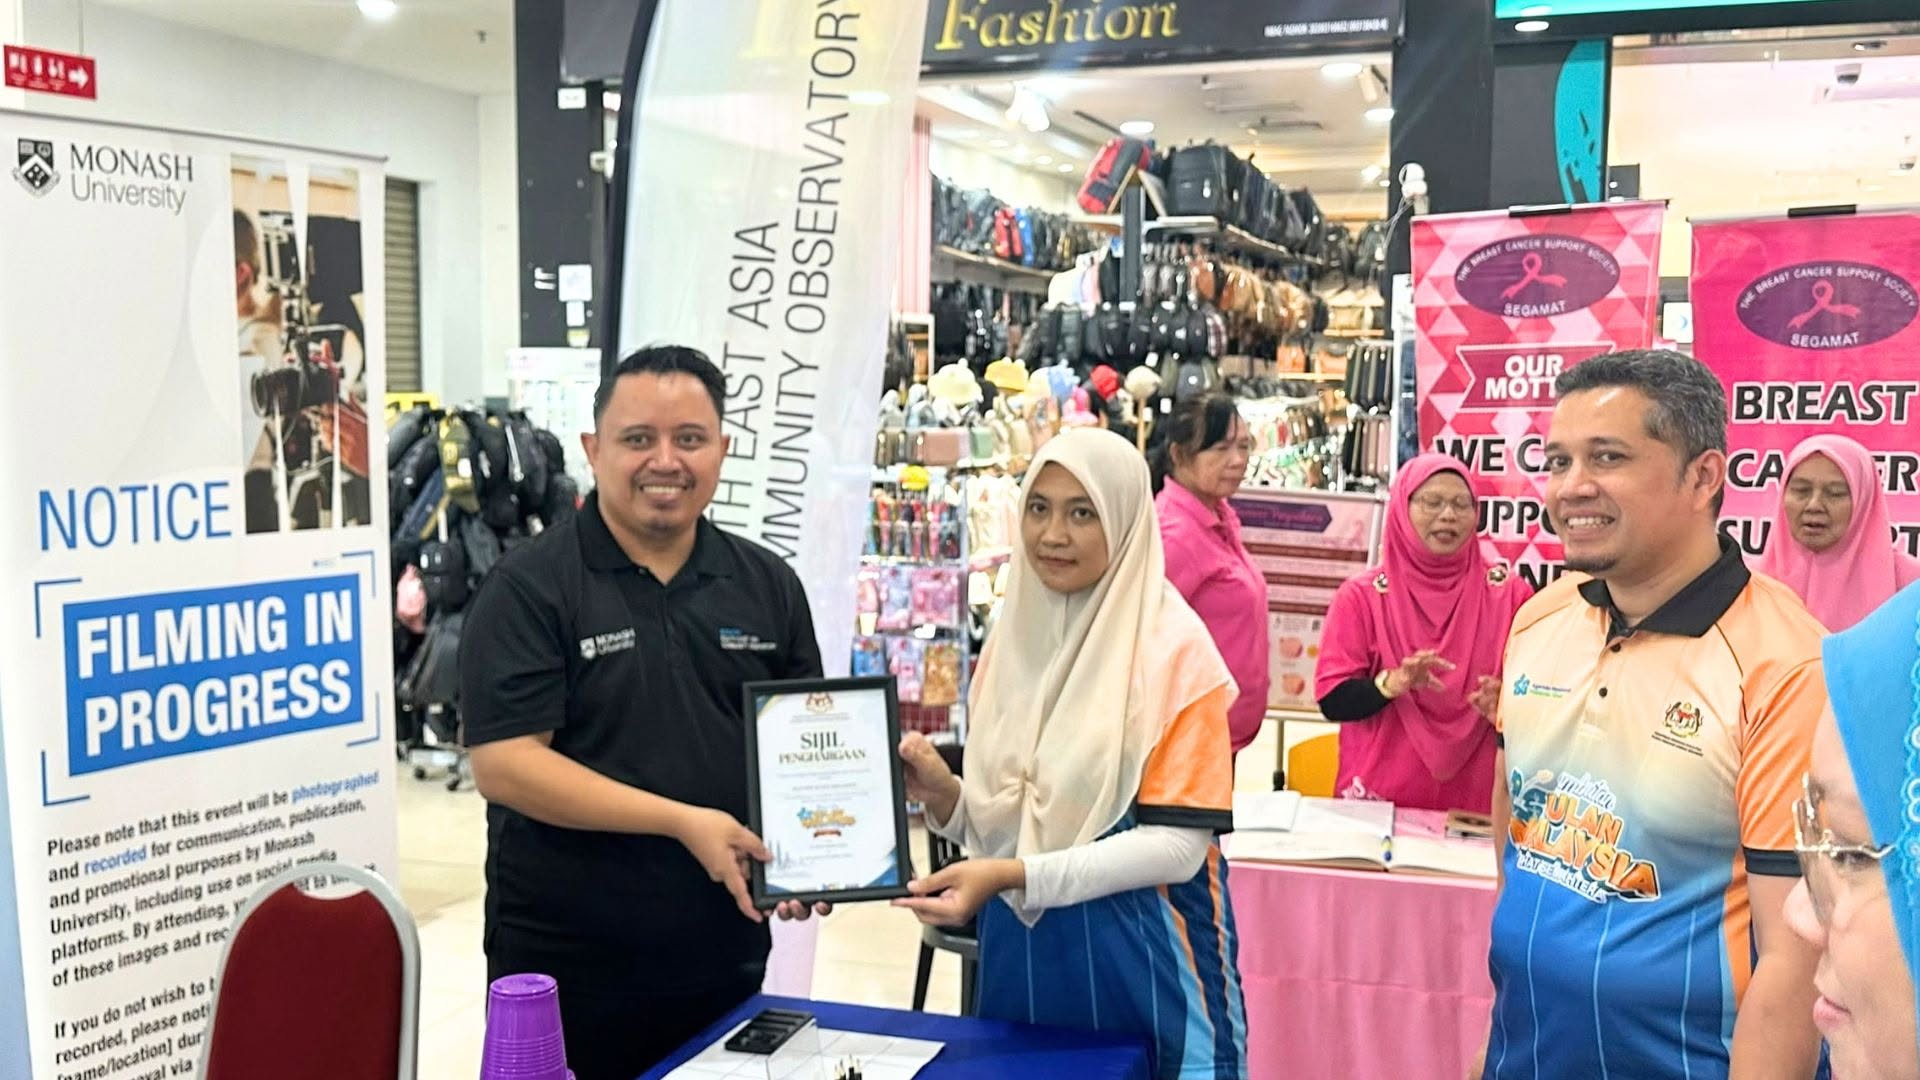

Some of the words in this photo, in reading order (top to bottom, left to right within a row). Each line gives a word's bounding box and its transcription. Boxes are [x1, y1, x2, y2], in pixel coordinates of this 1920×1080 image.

[934, 0, 1180, 50] Fashion
[70, 143, 194, 182] MONASH
[785, 0, 861, 333] OBSERVATOR
[70, 173, 187, 216] University
[1505, 238, 1541, 252] CANCER
[1544, 239, 1586, 252] SUPPORT
[728, 221, 779, 330] ASIA
[1755, 271, 1790, 294] BREAST
[1794, 266, 1833, 279] CANCER
[1837, 266, 1881, 282] SUPPORT
[1883, 277, 1918, 307] SOCIETY
[1504, 300, 1567, 318] SEGAMAT
[1791, 331, 1860, 348] SEGAMAT
[1485, 376, 1558, 400] MOTT
[1504, 354, 1564, 378] OUR
[1733, 384, 1917, 422] BREAST
[761, 350, 819, 561] MMUNITY
[38, 480, 232, 552] NOTICE
[77, 596, 288, 680] FILMING
[304, 589, 353, 647] IN
[84, 658, 352, 757] PROGRESS
[800, 731, 845, 750] SIJIL
[48, 834, 101, 856] Please
[105, 825, 134, 844] note
[139, 816, 167, 835] that
[172, 809, 200, 828] this
[205, 801, 243, 821] event
[247, 793, 269, 811] will
[273, 790, 289, 806] be
[48, 861, 80, 883] and
[84, 845, 147, 875] recorded
[151, 841, 171, 859] for
[49, 887, 80, 909] and
[85, 863, 171, 904] promotional
[175, 851, 241, 880] purposes
[245, 846, 260, 861] by
[264, 830, 316, 855] Monash
[51, 902, 132, 935] University,
[135, 883, 203, 912] including
[207, 877, 233, 894] use
[236, 873, 252, 887] on
[51, 929, 129, 965] platforms.
[133, 922, 150, 939] By
[155, 904, 230, 933] attending,
[52, 968, 69, 987] of
[74, 960, 114, 982] these
[117, 943, 169, 968] images
[173, 933, 201, 952] and
[54, 1021, 67, 1039] If
[71, 1014, 99, 1038] you
[103, 1007, 121, 1025] do
[124, 997, 147, 1017] not
[150, 984, 186, 1008] wish
[190, 980, 205, 997] to
[55, 1028, 128, 1065] recorded,
[131, 1013, 178, 1043] please
[182, 1002, 212, 1022] noti
[170, 1057, 193, 1077] via
